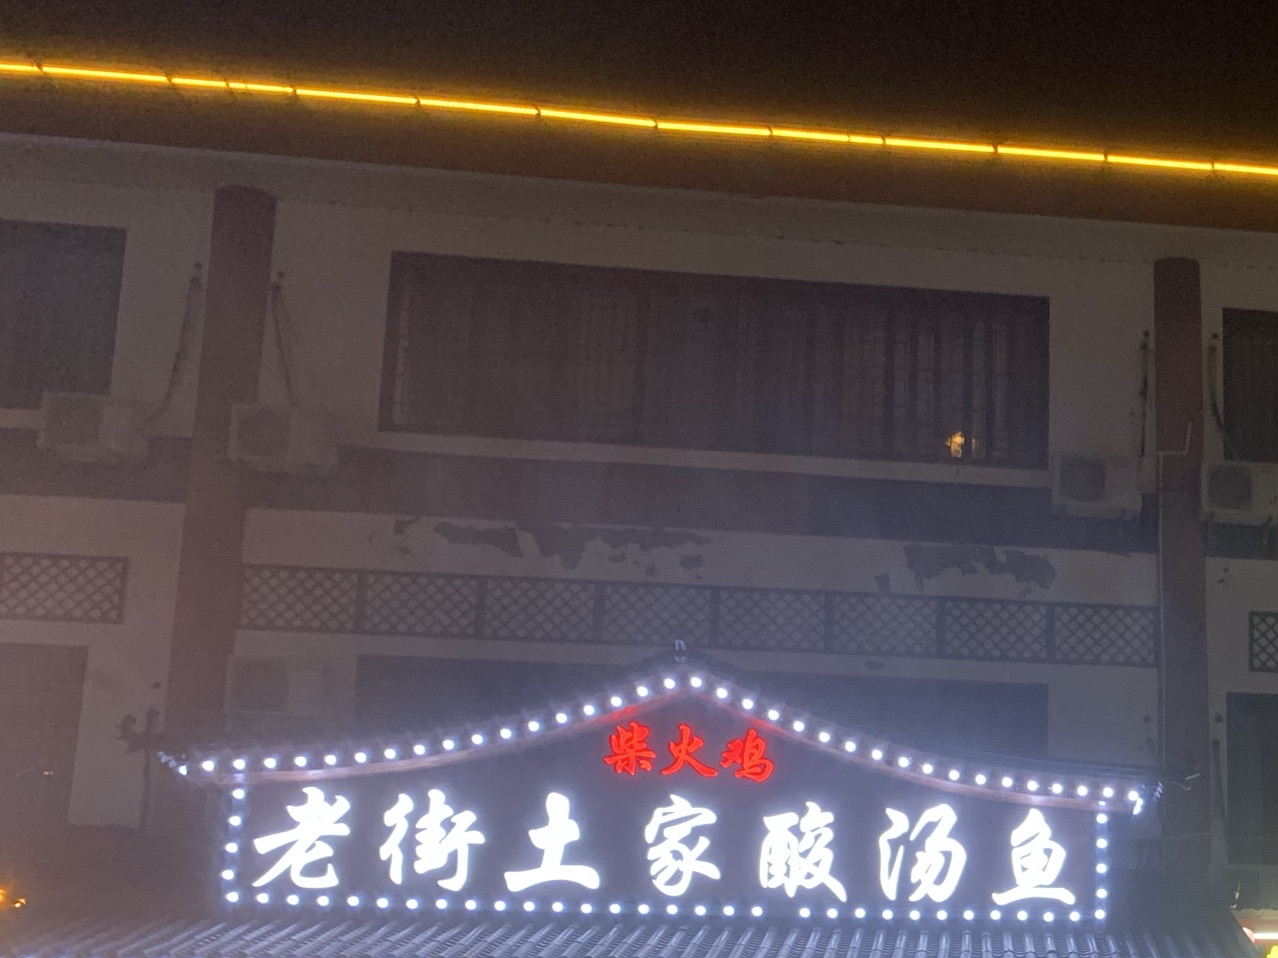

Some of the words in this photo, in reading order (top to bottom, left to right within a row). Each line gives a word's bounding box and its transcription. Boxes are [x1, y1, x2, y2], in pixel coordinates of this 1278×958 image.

[603, 721, 774, 783] 柴火鸡
[252, 786, 1078, 908] 老街土家酸汤鱼
